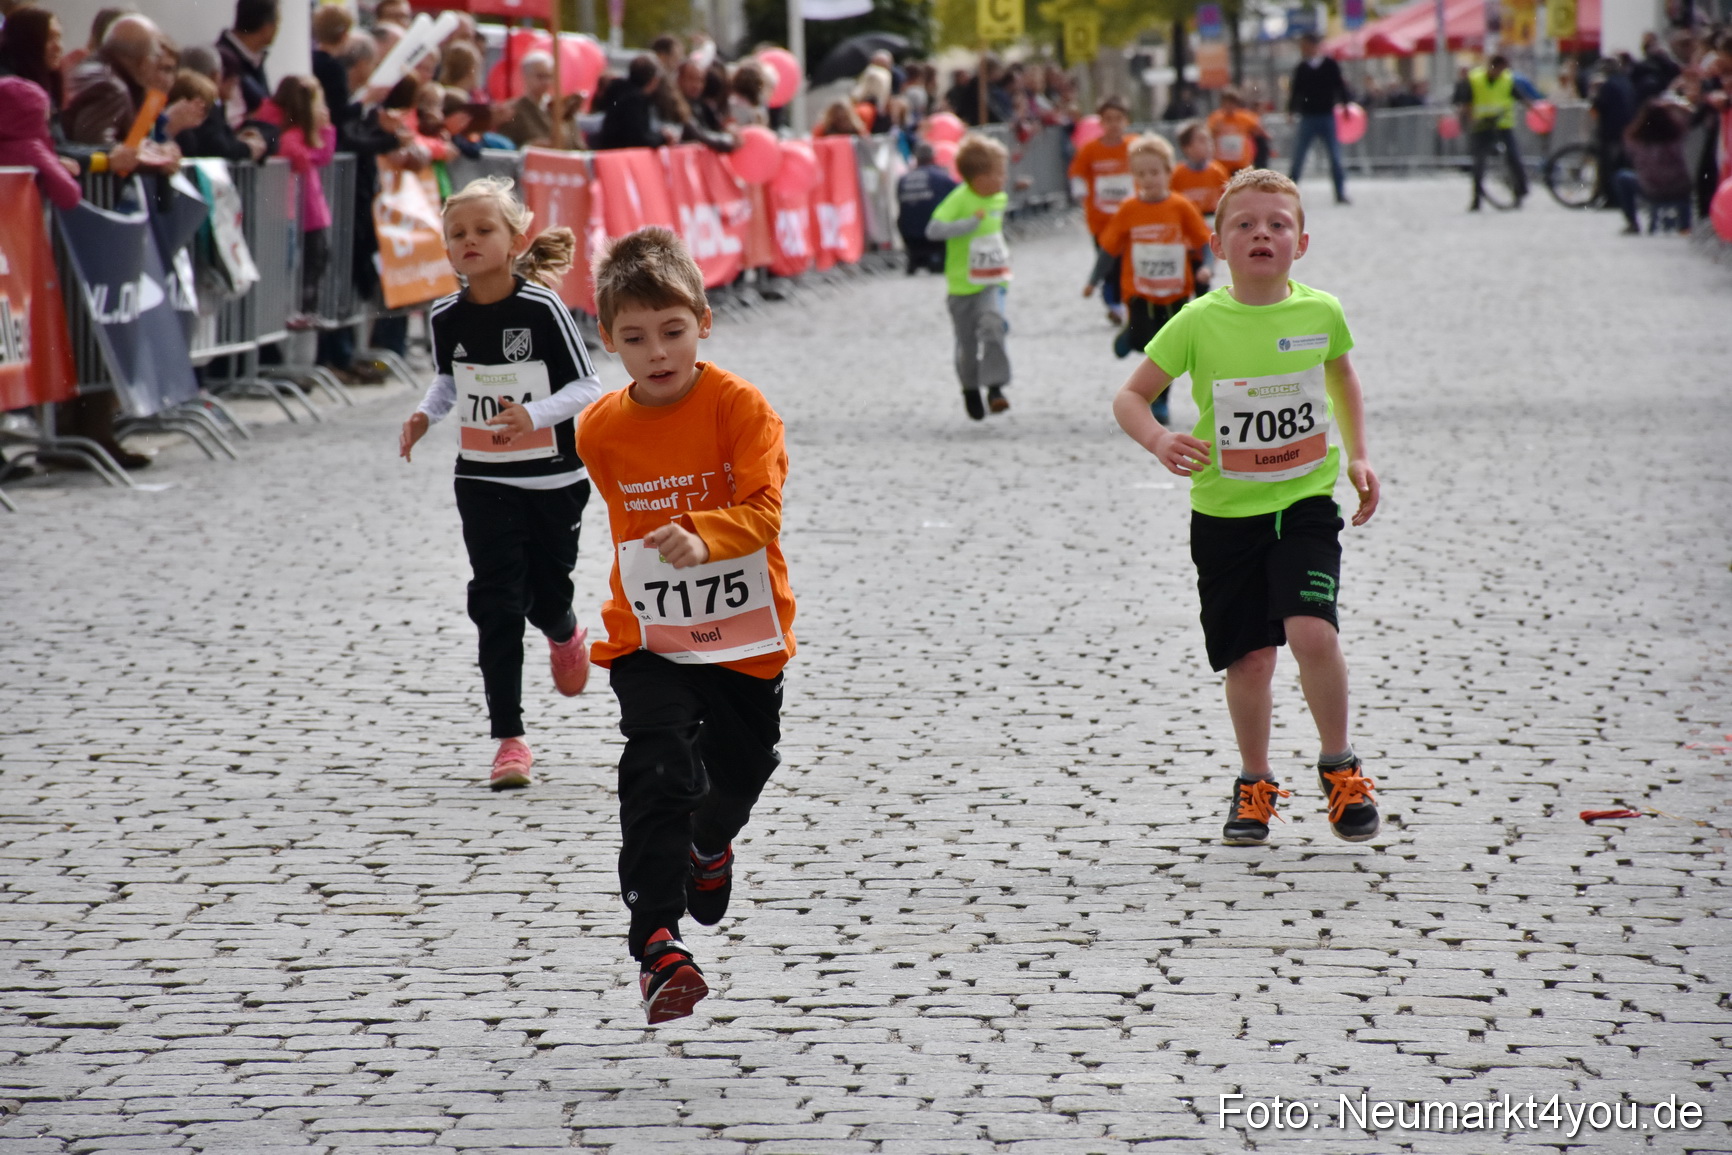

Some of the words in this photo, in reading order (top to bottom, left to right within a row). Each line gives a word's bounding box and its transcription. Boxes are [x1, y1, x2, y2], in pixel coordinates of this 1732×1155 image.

[1259, 382, 1300, 397] BOCK
[1233, 402, 1315, 443] 7083
[1255, 449, 1300, 465] Leander
[644, 569, 749, 618] 7175
[690, 627, 722, 644] Noel
